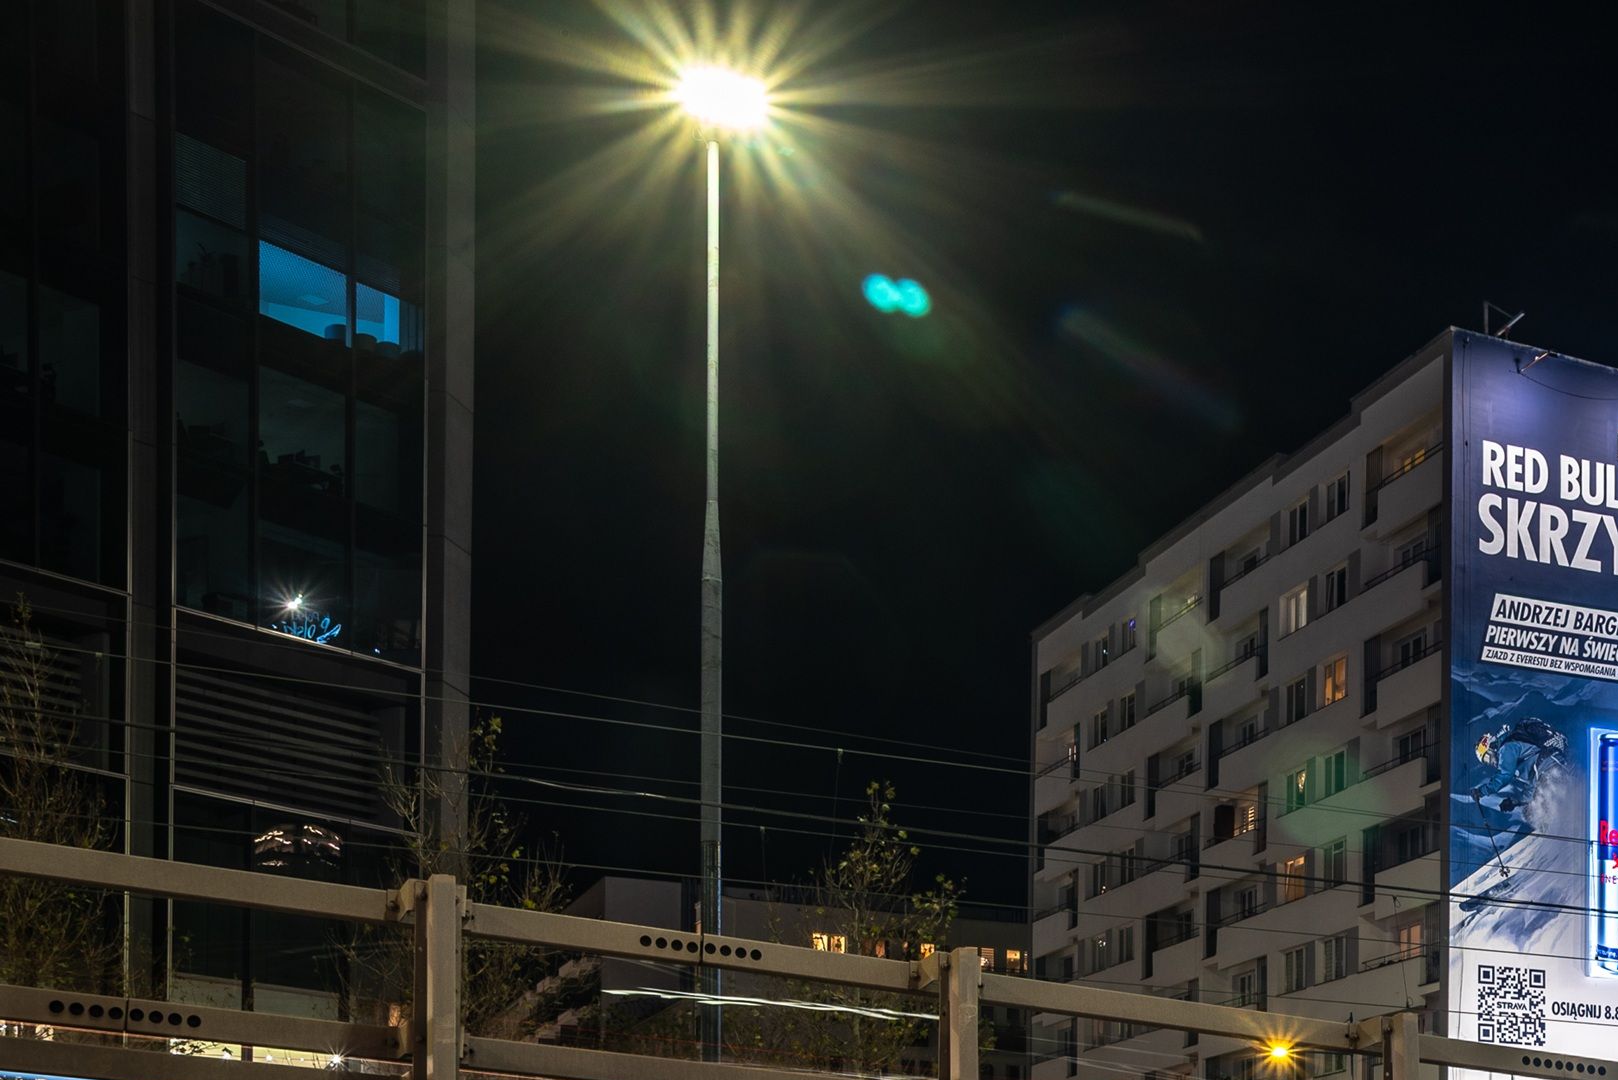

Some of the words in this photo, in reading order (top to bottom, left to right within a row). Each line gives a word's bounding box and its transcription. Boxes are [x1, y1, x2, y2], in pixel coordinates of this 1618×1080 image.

[1482, 439, 1549, 494] RED
[1495, 598, 1570, 628] ANDRZEJ
[1485, 624, 1558, 652] PIERWSZY
[1559, 637, 1579, 656] NA
[1486, 648, 1507, 662] ZJAZD
[1508, 652, 1515, 662] Z
[1516, 653, 1549, 668] EVERESTU
[1550, 659, 1563, 670] BEZ
[1564, 661, 1616, 678] WSPOMAGANIA
[1496, 1001, 1528, 1011] STRAVA
[1551, 1001, 1603, 1021] OSIĄGNIJ
